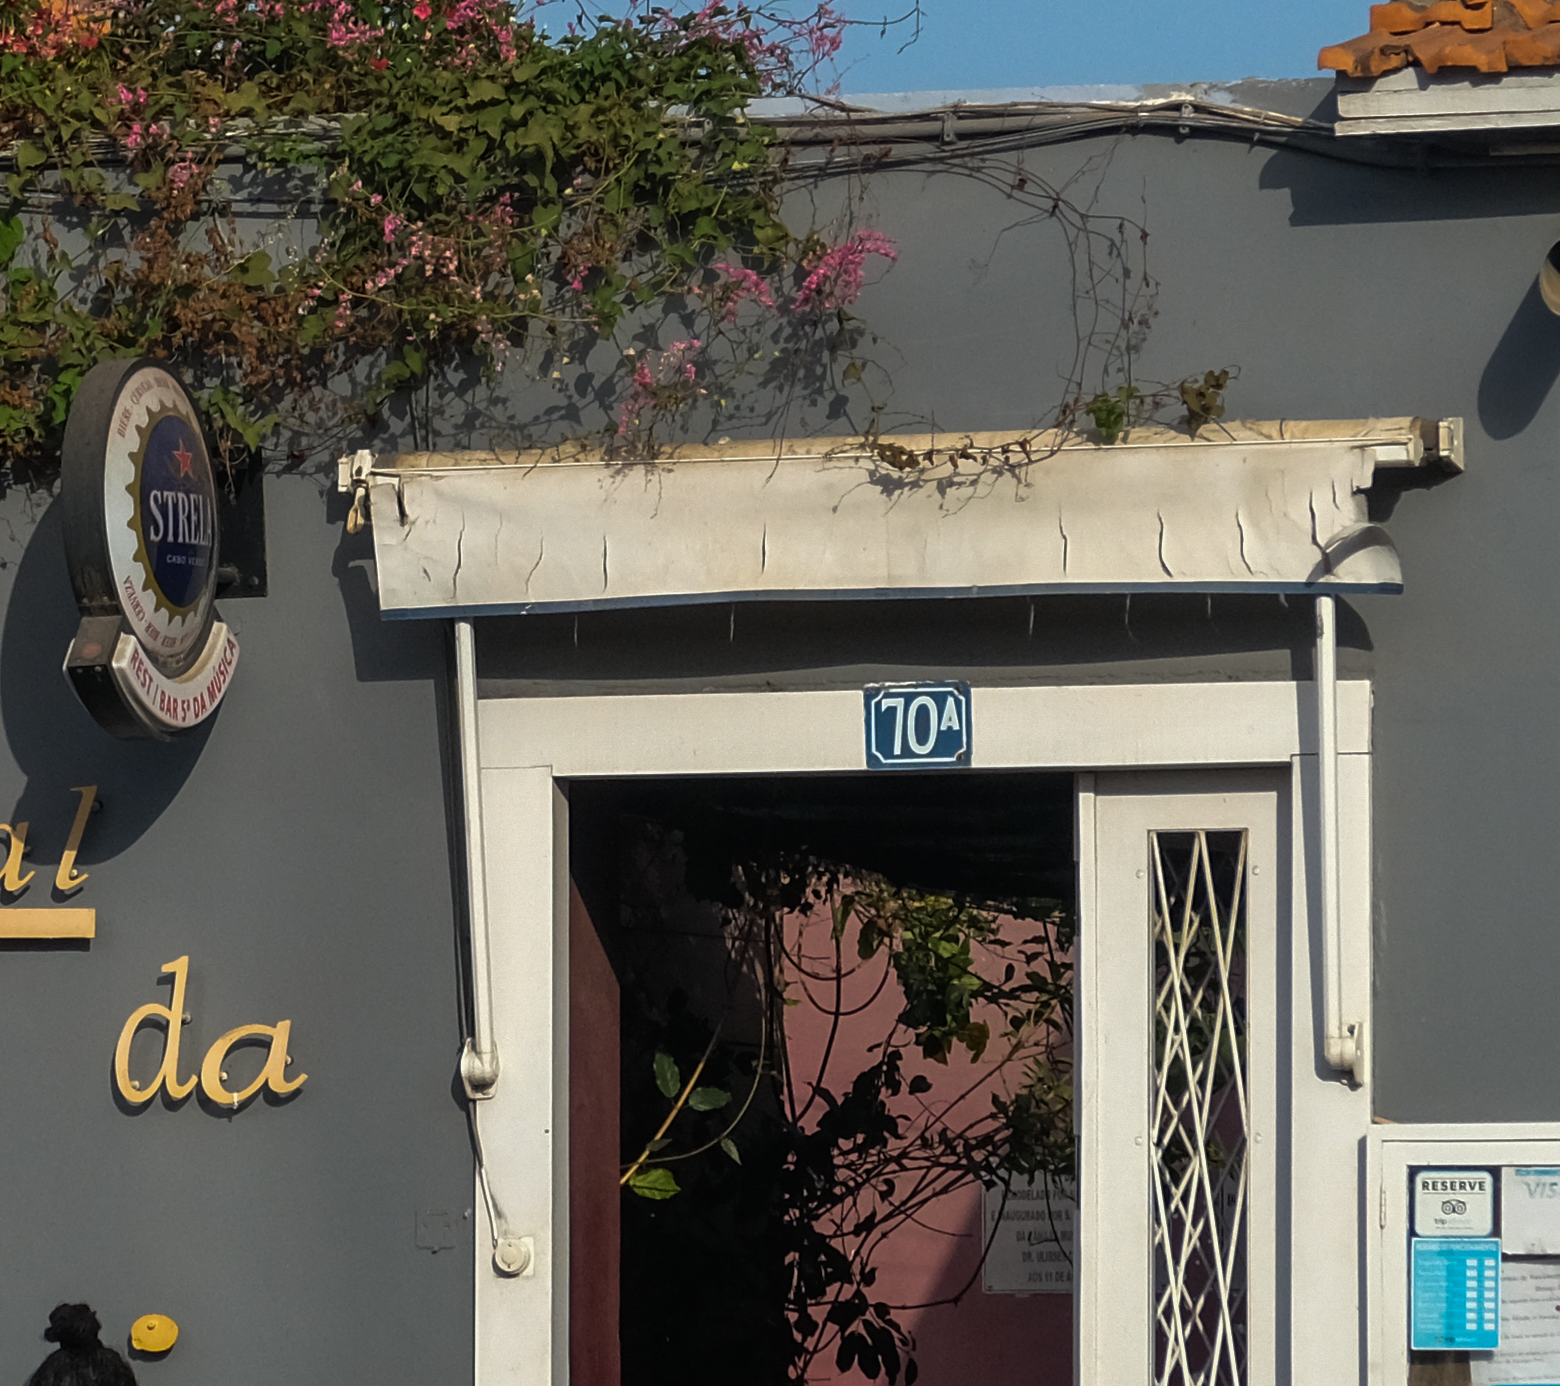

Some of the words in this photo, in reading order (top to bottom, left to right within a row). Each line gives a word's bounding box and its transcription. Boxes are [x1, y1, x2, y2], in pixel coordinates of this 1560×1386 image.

[149, 489, 213, 546] STRELA
[131, 648, 154, 696] REST
[159, 690, 180, 720] BAR
[192, 692, 207, 719] DA
[207, 637, 237, 707] MÚSICA
[881, 695, 960, 755] 70A
[113, 955, 309, 1108] da
[1422, 1180, 1487, 1191] RESERVE
